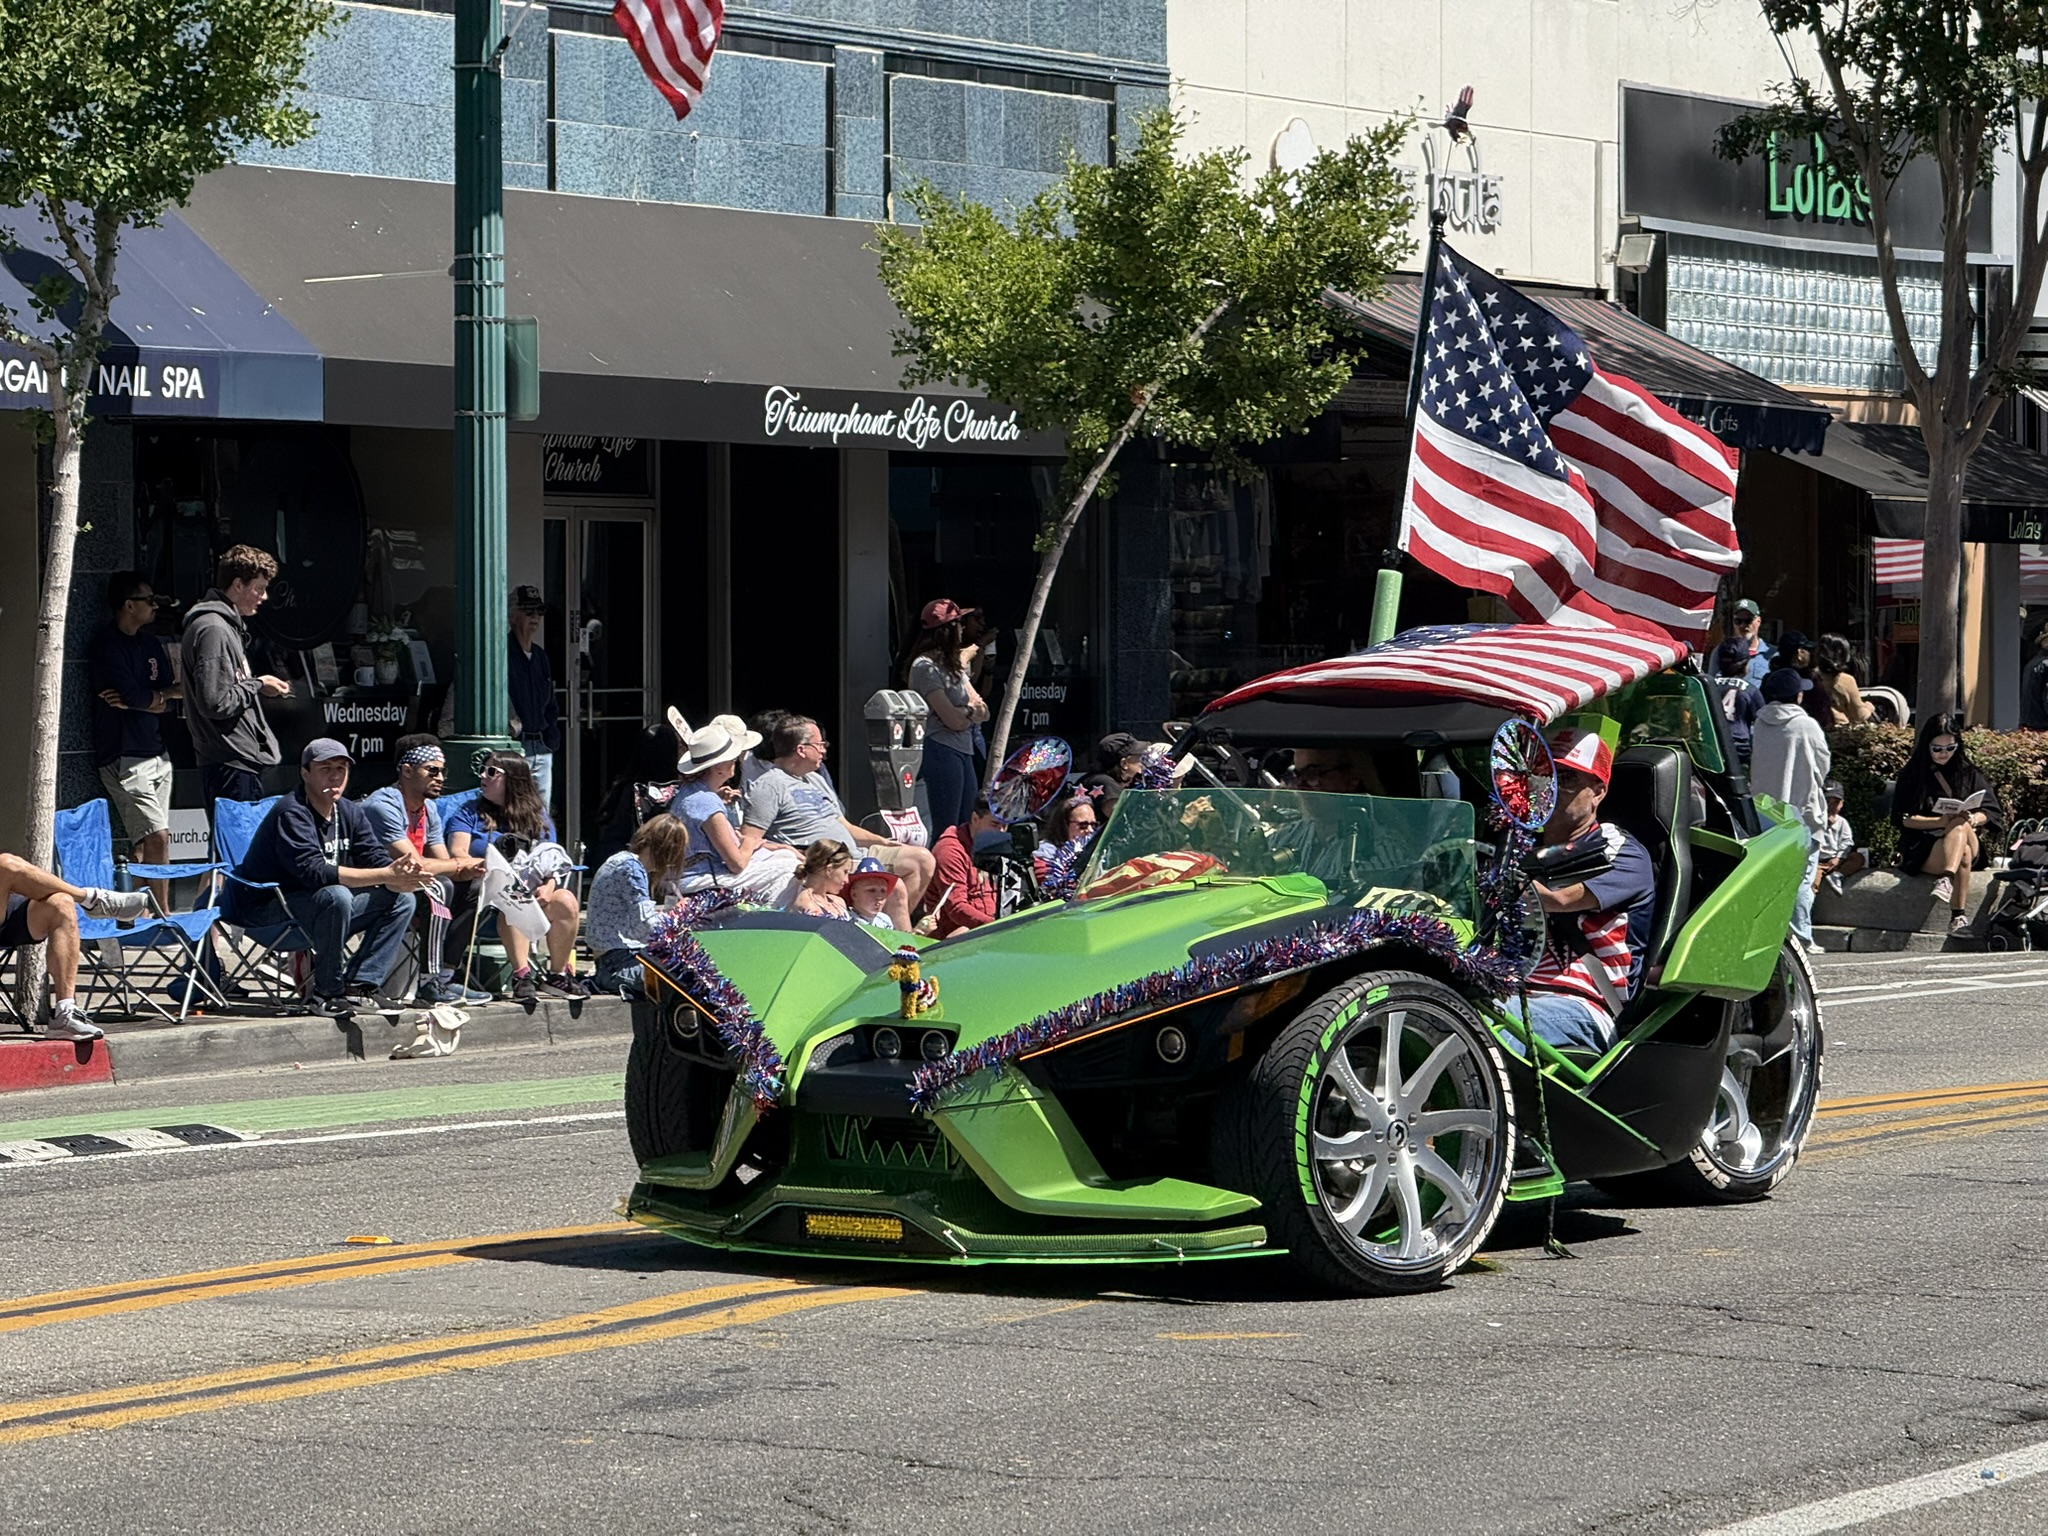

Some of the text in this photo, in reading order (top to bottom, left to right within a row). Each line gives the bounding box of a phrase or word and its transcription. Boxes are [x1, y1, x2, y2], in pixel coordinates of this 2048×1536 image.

[98, 364, 152, 397] NAIL
[161, 365, 205, 399] SPA
[765, 385, 1020, 449] Triumphant Life Church
[544, 451, 602, 482] Church
[1003, 682, 1068, 703] dnesday
[323, 701, 408, 727] Wednesday
[1022, 708, 1050, 730] 7 pm
[349, 733, 384, 758] 7 pm
[1294, 1050, 1320, 1206] MONEY
